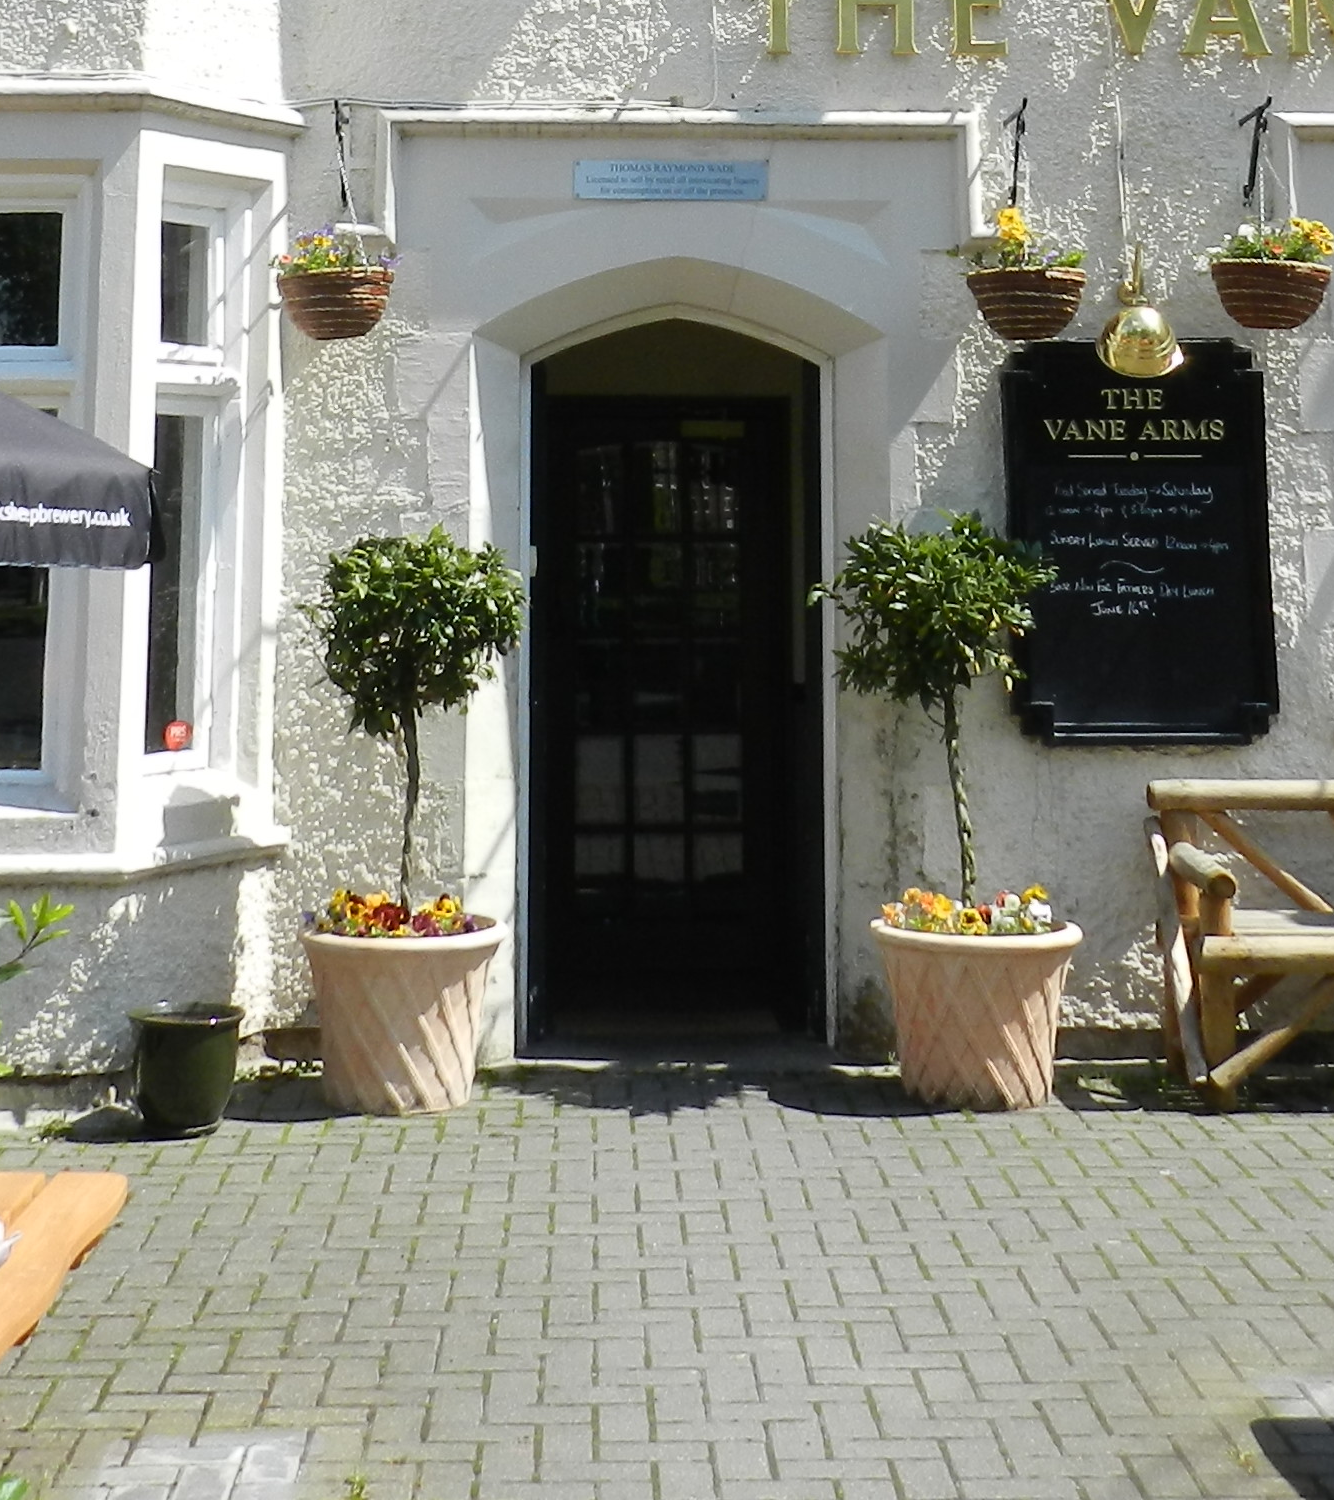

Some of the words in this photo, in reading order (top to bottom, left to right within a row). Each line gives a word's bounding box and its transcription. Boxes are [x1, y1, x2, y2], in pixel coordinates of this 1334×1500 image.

[610, 163, 652, 173] THOMAS
[654, 163, 705, 173] RAYMOND
[707, 163, 734, 173] WADE
[1101, 388, 1164, 410] THE
[1043, 419, 1127, 441] VANE
[1138, 419, 1225, 441] ARMS
